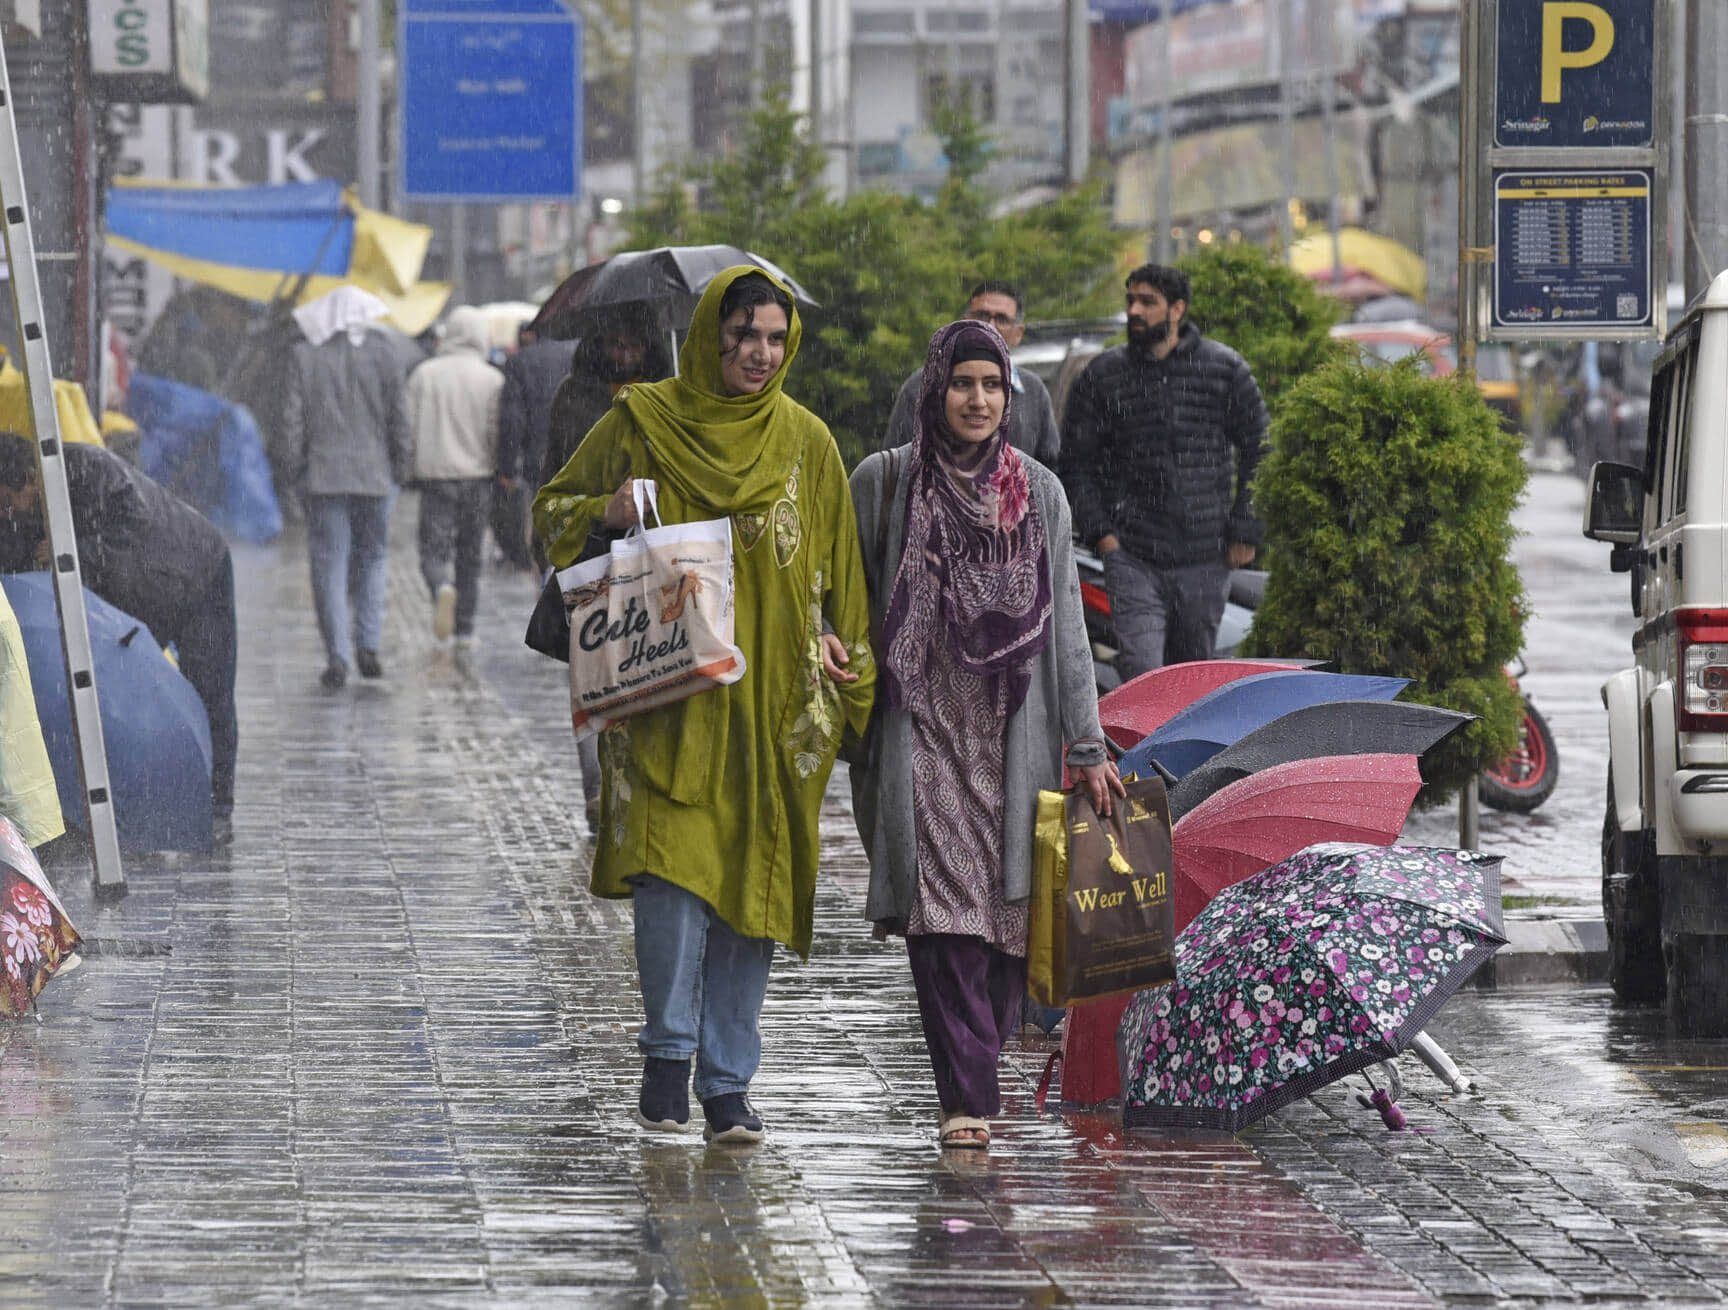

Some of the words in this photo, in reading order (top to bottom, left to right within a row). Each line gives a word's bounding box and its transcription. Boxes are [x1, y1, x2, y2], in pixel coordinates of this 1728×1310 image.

[1541, 2, 1615, 104] P
[618, 621, 689, 673] Heels
[1073, 887, 1127, 913] Wear
[1131, 871, 1167, 902] Well
